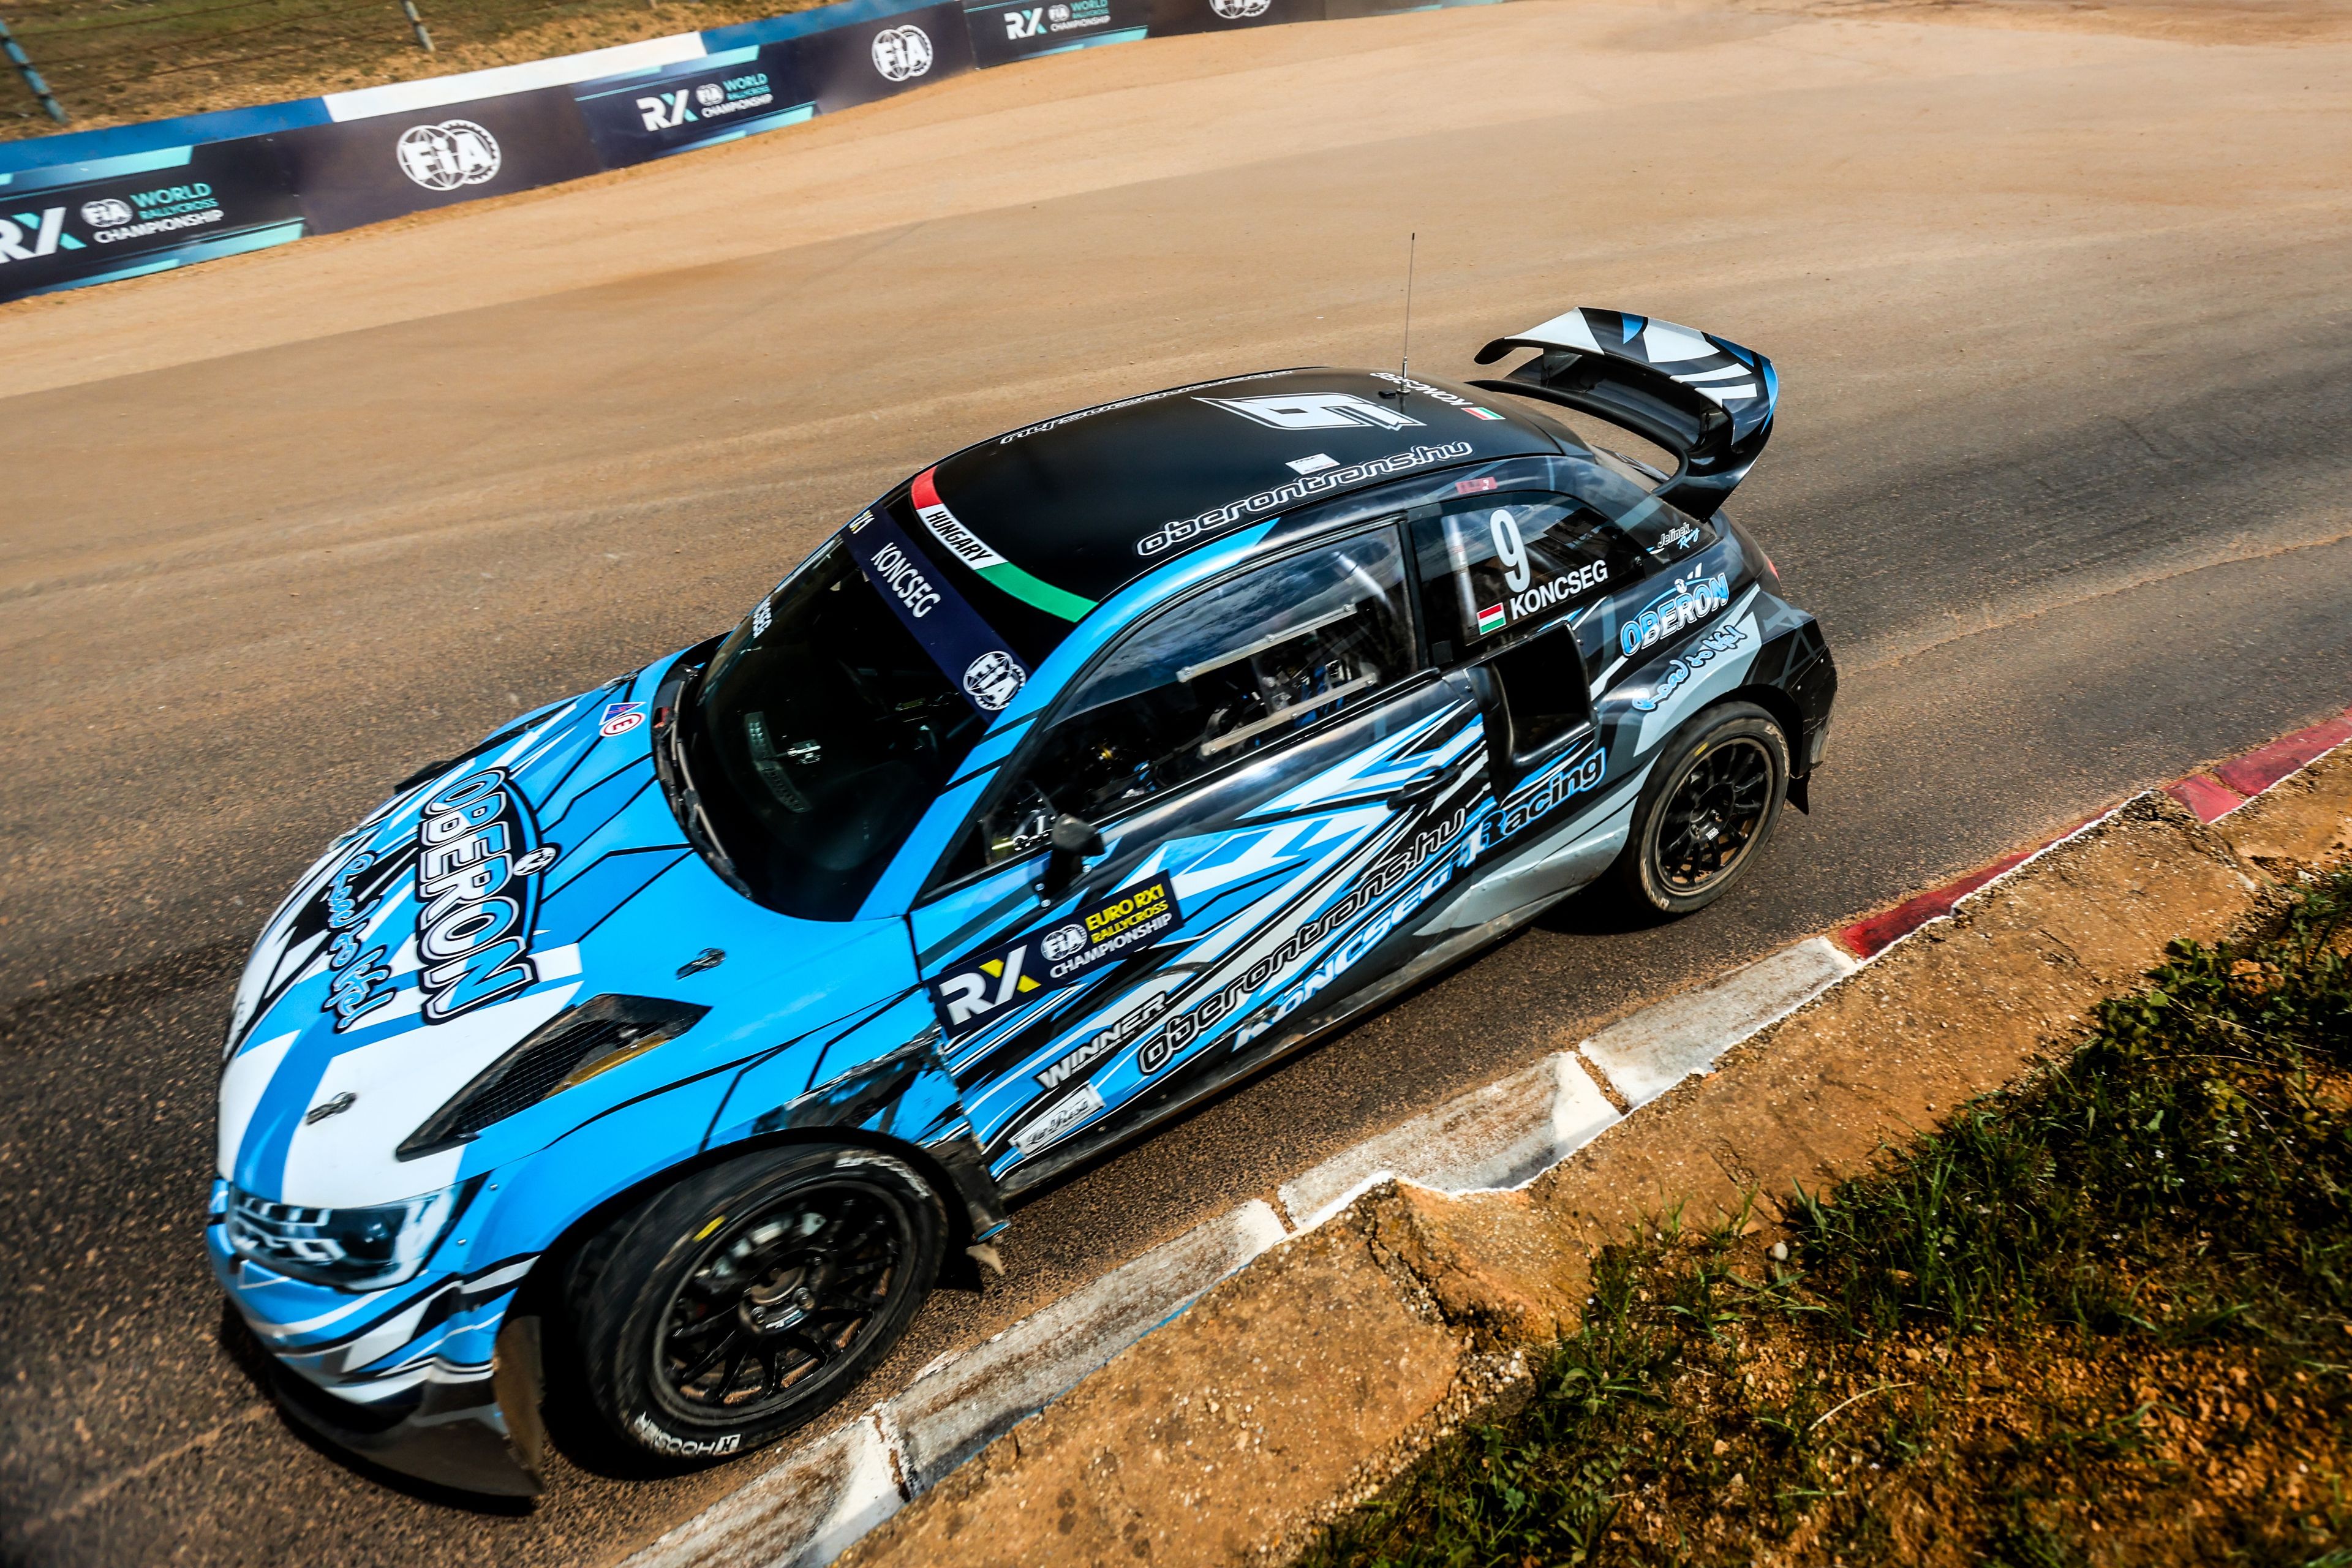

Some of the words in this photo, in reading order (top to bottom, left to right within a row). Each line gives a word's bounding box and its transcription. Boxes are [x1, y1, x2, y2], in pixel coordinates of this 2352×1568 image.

[1004, 7, 1047, 40] RX
[1071, 0, 1108, 11] WORLD
[722, 73, 769, 91] WORLD
[636, 89, 699, 131] RX
[130, 183, 212, 208] WORLD
[138, 198, 219, 220] RALLYCROSS
[93, 209, 224, 244] CHAMPIONSHIP
[1137, 441, 1473, 556] oberontrans.hu
[926, 511, 993, 562] HUNGARY
[1490, 509, 1531, 593] 9
[870, 542, 941, 617] KONCSEG
[1510, 560, 1608, 620] KONCSEG
[1620, 572, 1730, 657] OBERON
[421, 768, 535, 1023] OBERON
[1085, 899, 1134, 931] EURO
[1133, 883, 1165, 908] RX1
[1090, 900, 1169, 944] RALLYCROSS
[1049, 913, 1172, 978] CHAMPIONSHIP
[1138, 806, 1467, 1076] oberontrans.hu
[938, 944, 1041, 1026] RX
[1036, 992, 1166, 1088] WINNER
